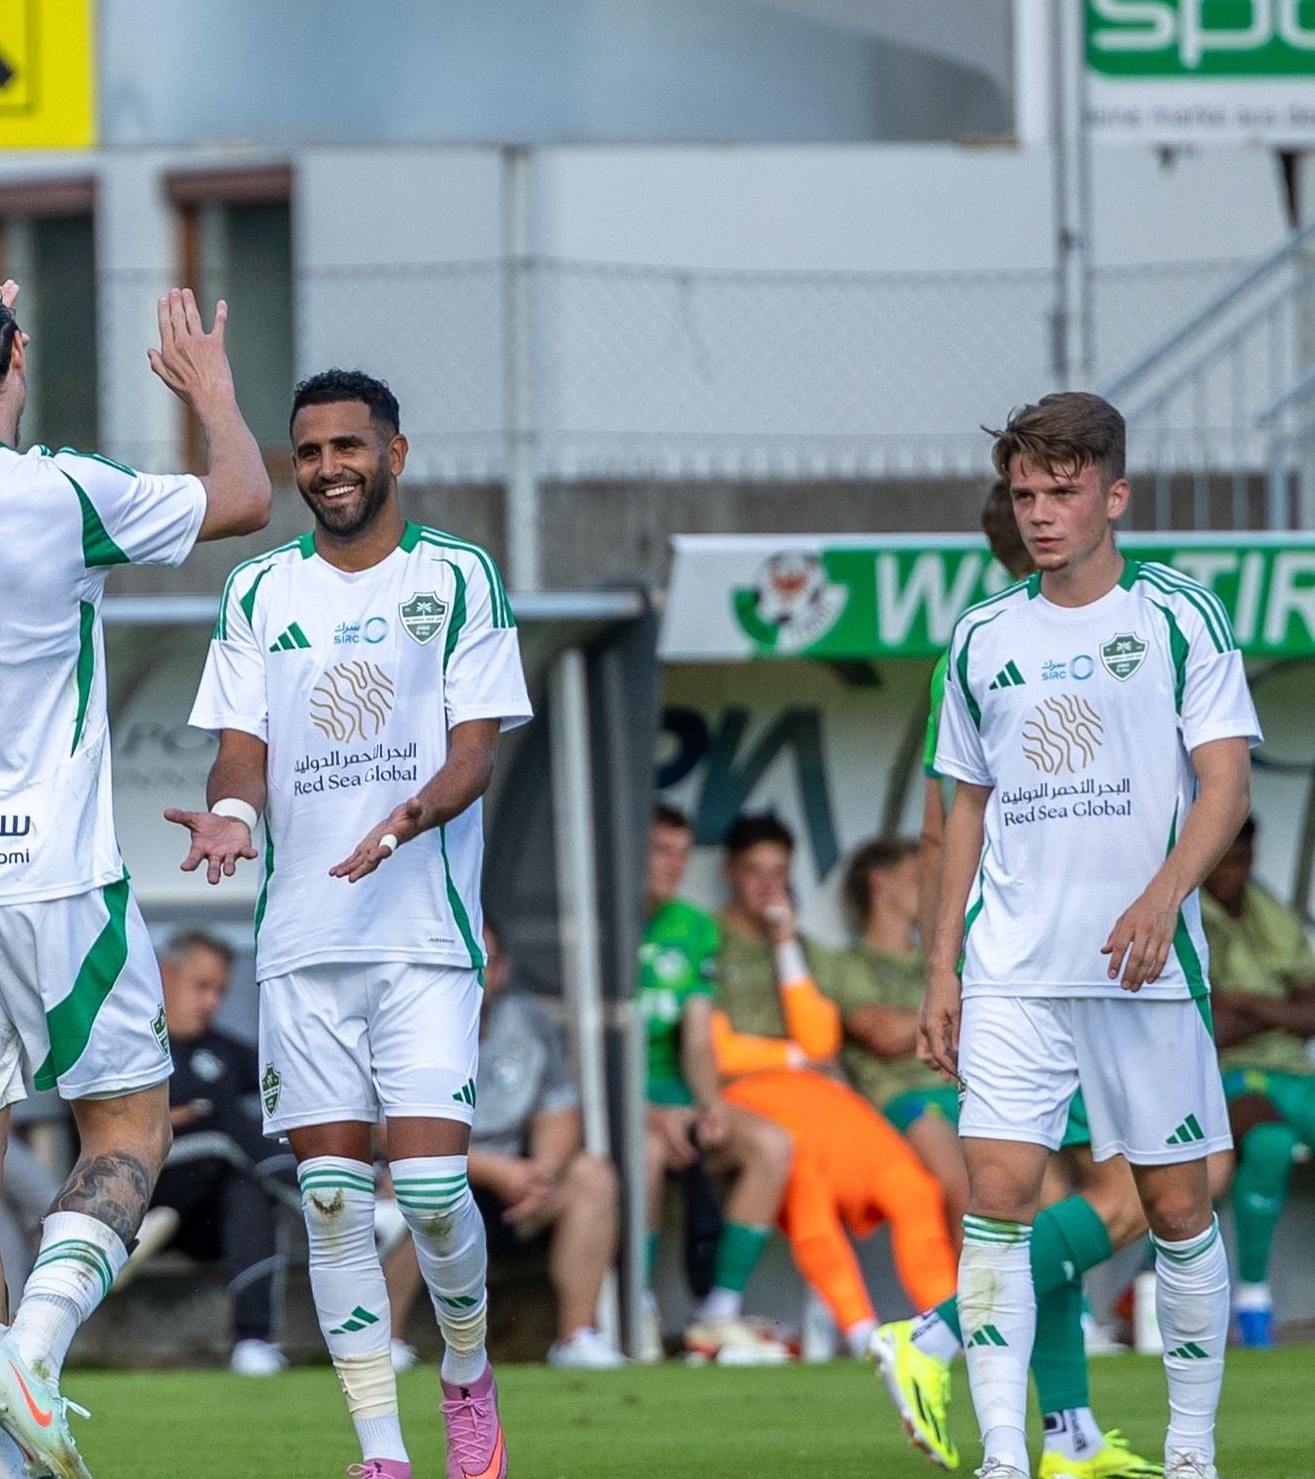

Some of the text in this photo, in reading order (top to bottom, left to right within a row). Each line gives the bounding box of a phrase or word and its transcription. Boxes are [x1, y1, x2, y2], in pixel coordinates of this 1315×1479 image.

[385, 743, 417, 762] البحر
[294, 764, 417, 796] Red Sea Global
[1096, 778, 1130, 797] البحر
[1001, 782, 1048, 806] الدولية
[1004, 799, 1132, 827] Red Sea Global
